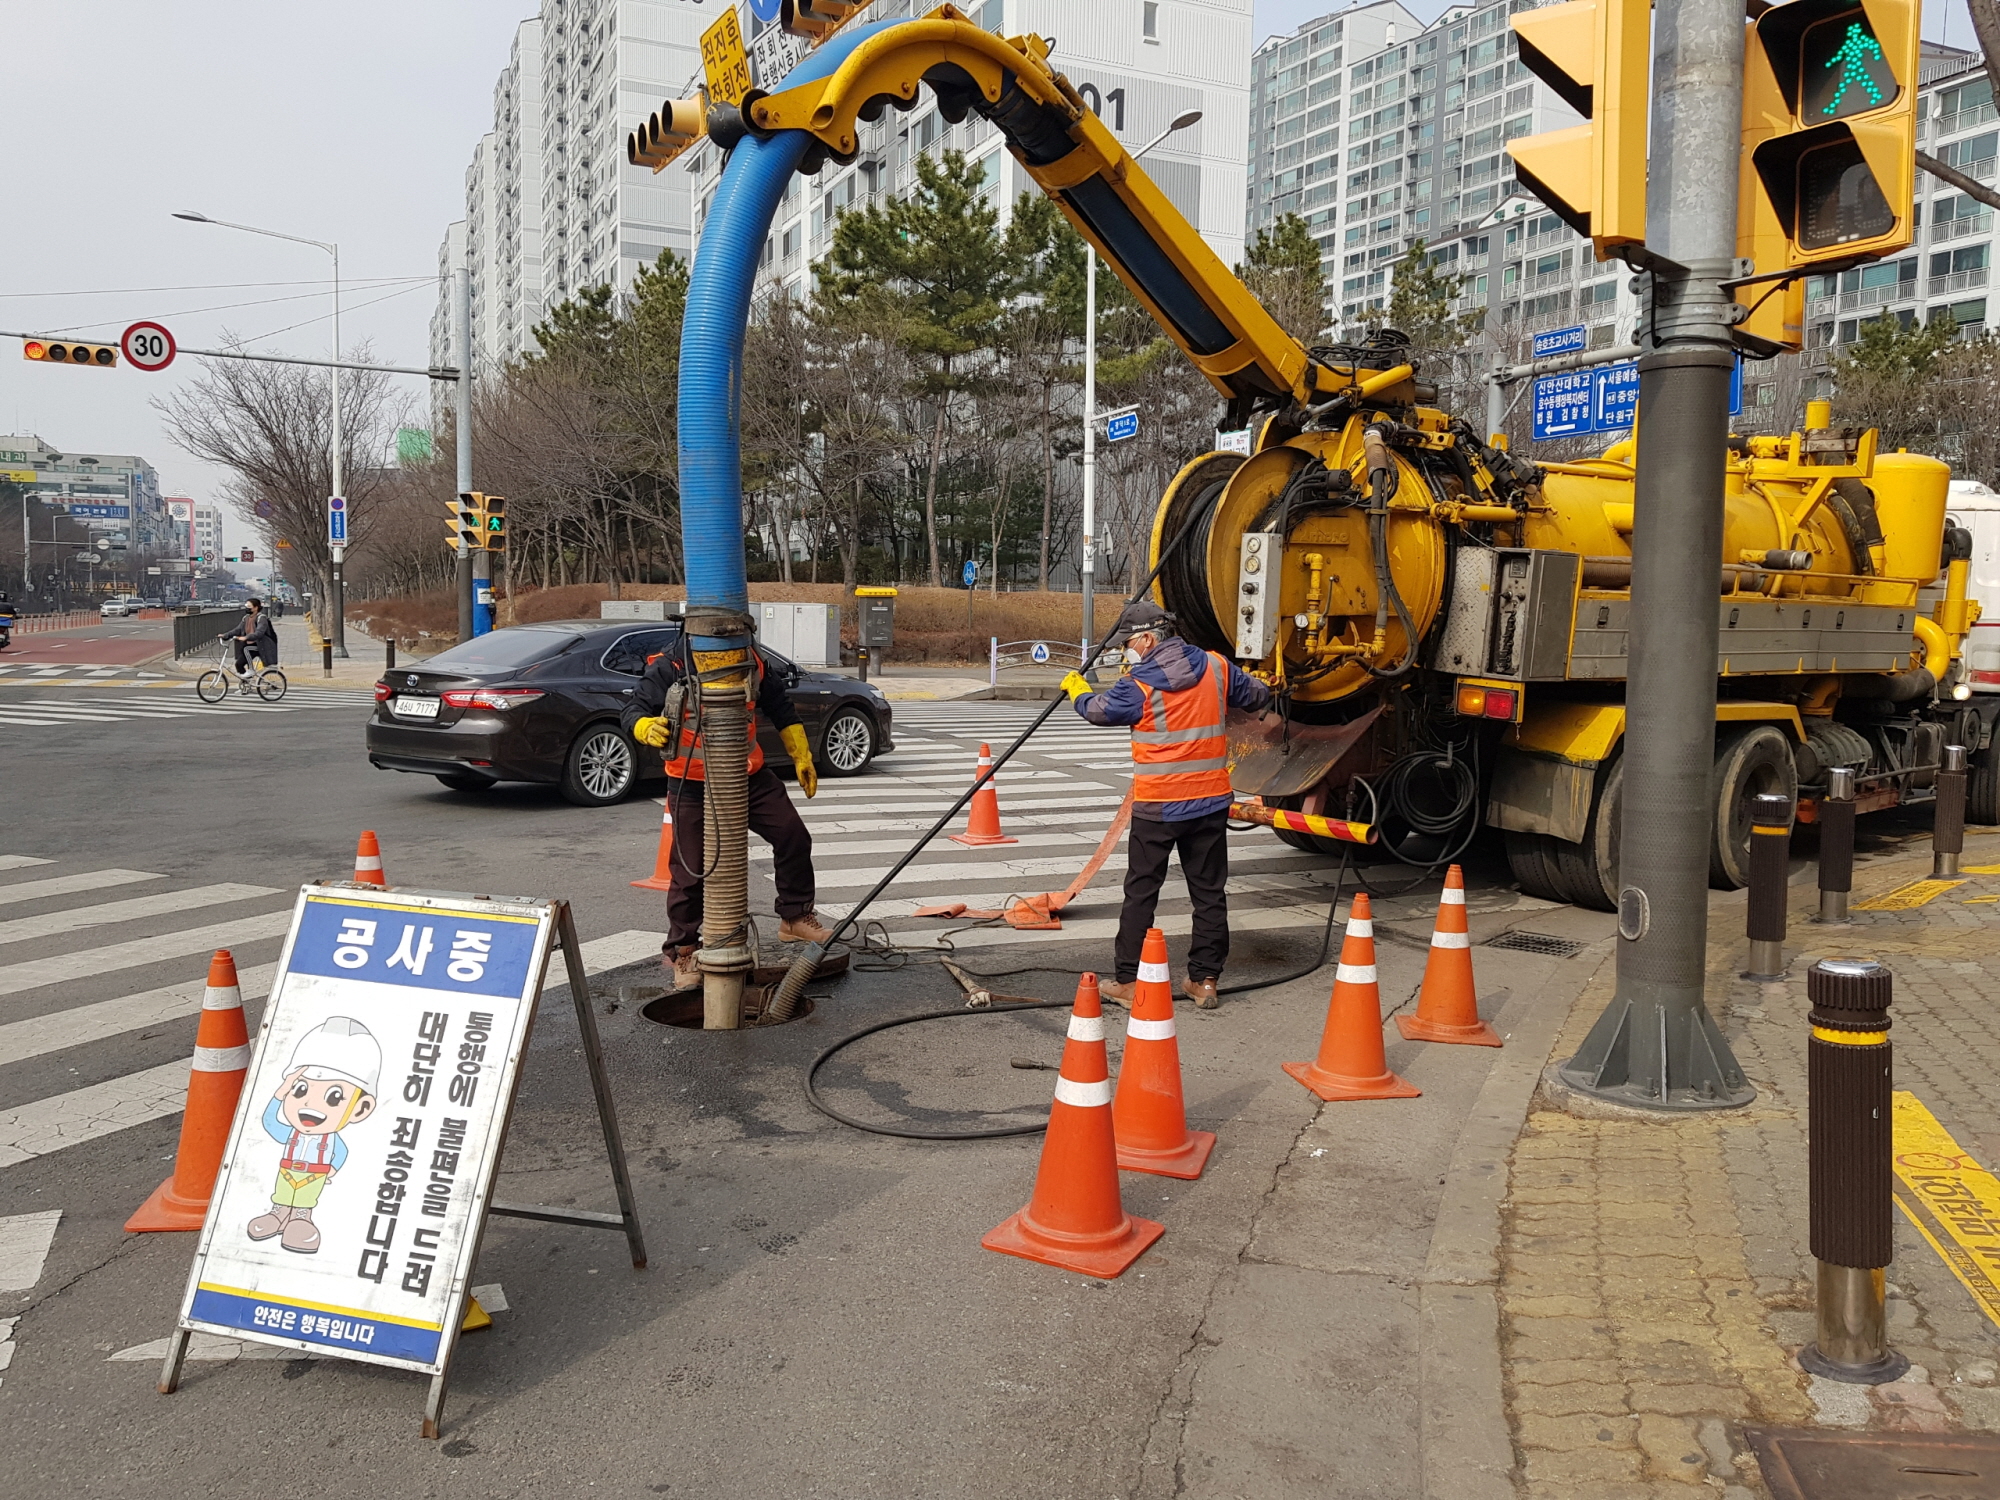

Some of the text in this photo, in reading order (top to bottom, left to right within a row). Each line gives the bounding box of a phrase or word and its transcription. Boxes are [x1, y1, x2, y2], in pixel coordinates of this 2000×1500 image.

[703, 17, 739, 69] 직진후
[757, 28, 800, 65] 좌회전
[711, 57, 749, 102] 좌회전
[133, 333, 164, 359] 30
[1535, 330, 1582, 352] 송호초교사거리
[1538, 374, 1590, 396] 신안산대학교
[1607, 368, 1640, 385] 서울예술
[1538, 390, 1589, 411] 호수동행정복지센터
[1617, 390, 1640, 404] 중앙
[1605, 409, 1635, 425] 단원구
[0, 451, 25, 462] 내과
[415, 702, 435, 714] 7177
[331, 917, 492, 982] 공사중
[357, 1011, 449, 1284] 대단히 죄송합니다
[401, 1011, 495, 1298] 통행에 불편을 드려
[252, 1304, 376, 1345] 안전은 행복입니다
